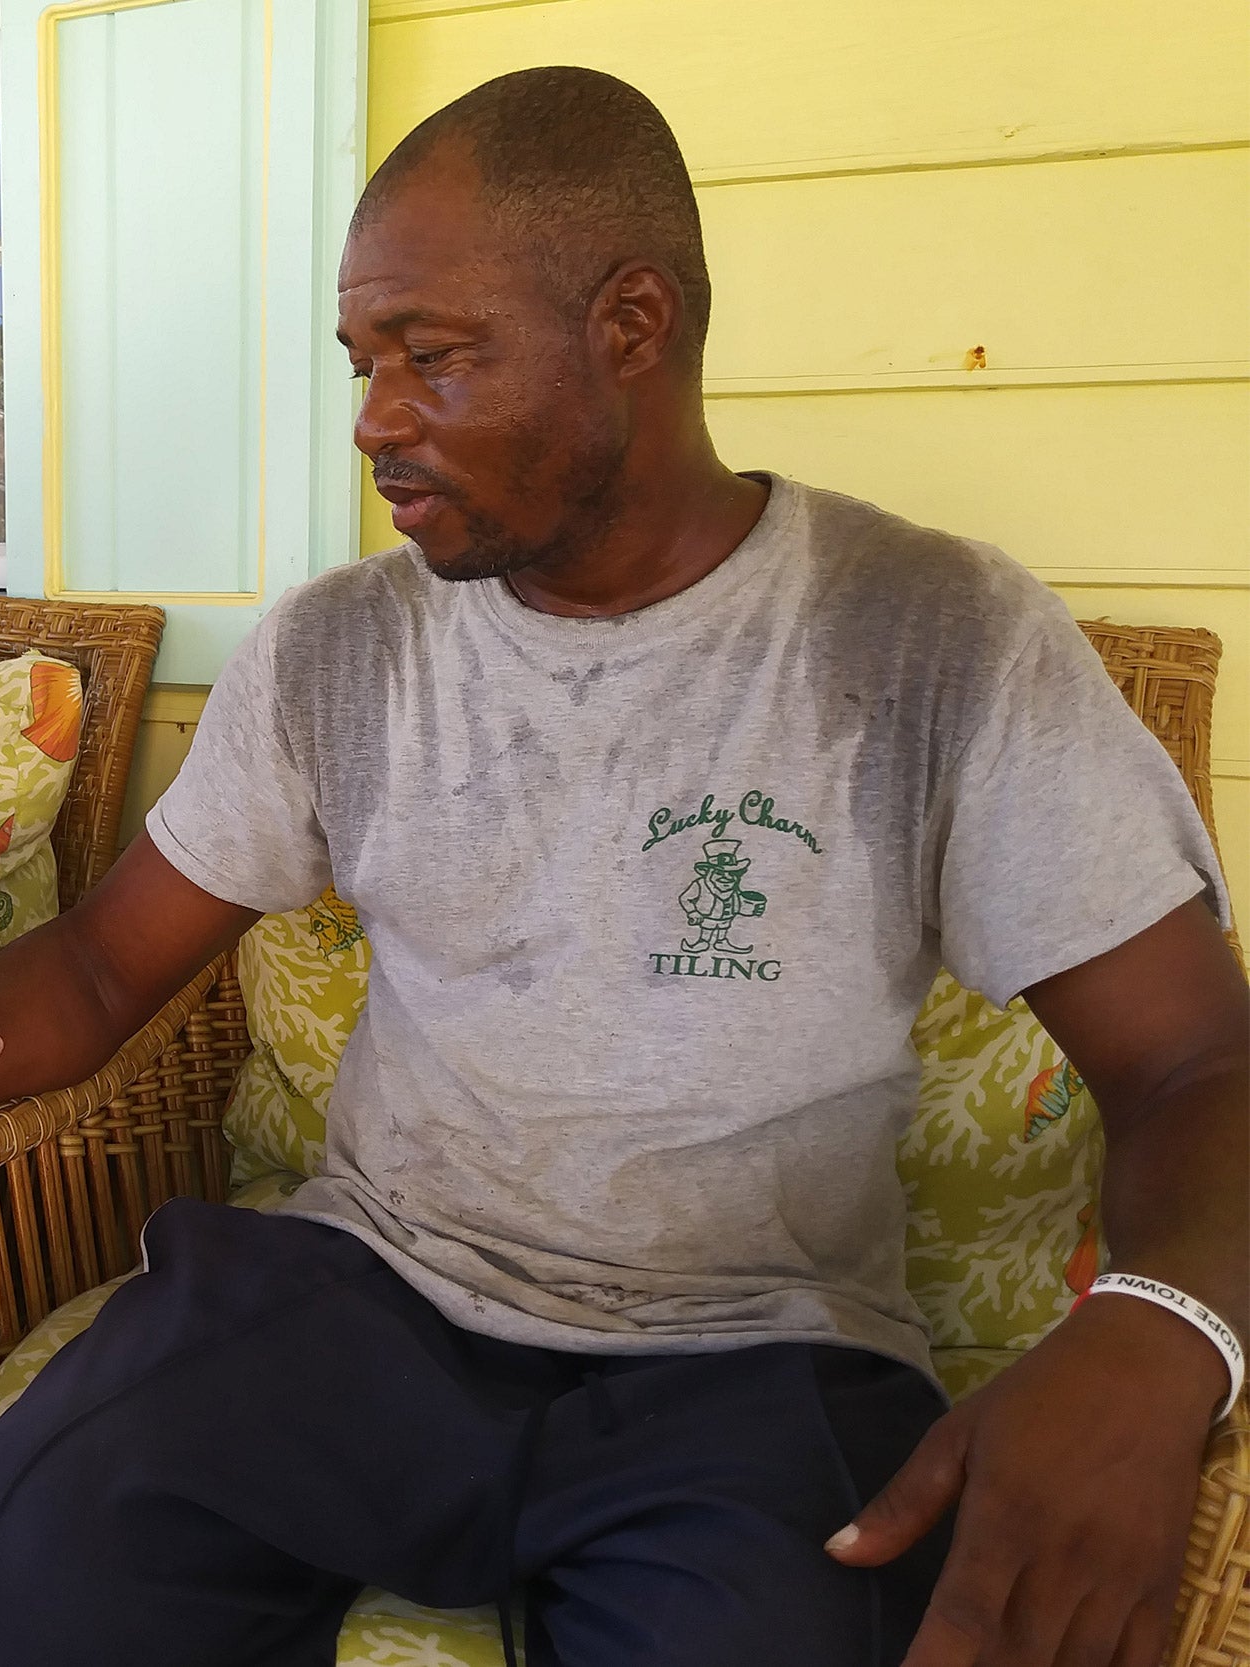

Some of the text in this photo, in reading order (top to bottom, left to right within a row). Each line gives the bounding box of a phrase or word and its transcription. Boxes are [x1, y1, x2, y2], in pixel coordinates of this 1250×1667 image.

[641, 789, 822, 854] Lucky Charm
[649, 953, 782, 981] TILING
[1118, 1276, 1188, 1309] TOWN
[1194, 1306, 1240, 1362] HOPE
